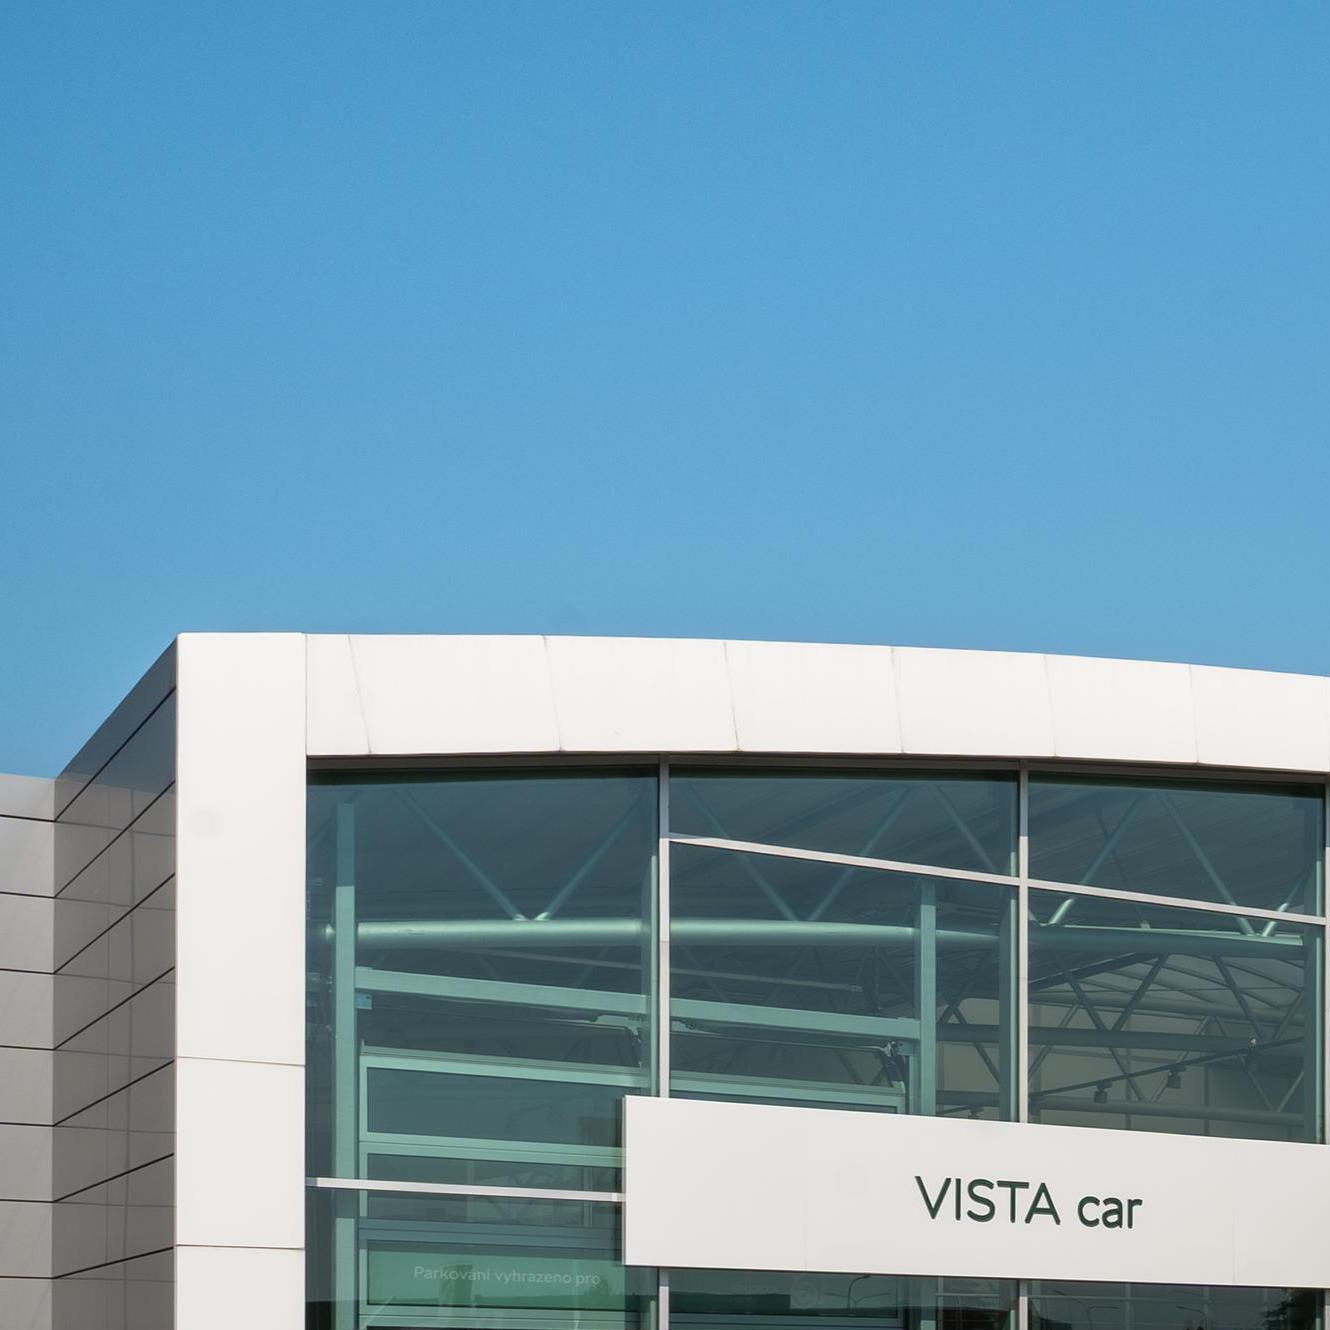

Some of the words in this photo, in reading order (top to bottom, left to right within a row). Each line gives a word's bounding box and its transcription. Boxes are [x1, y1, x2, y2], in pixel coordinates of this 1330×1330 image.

[914, 1175, 1061, 1225] VISTA
[1077, 1195, 1143, 1229] car
[413, 1265, 491, 1281] Parkování
[494, 1269, 573, 1284] vyhrazeno
